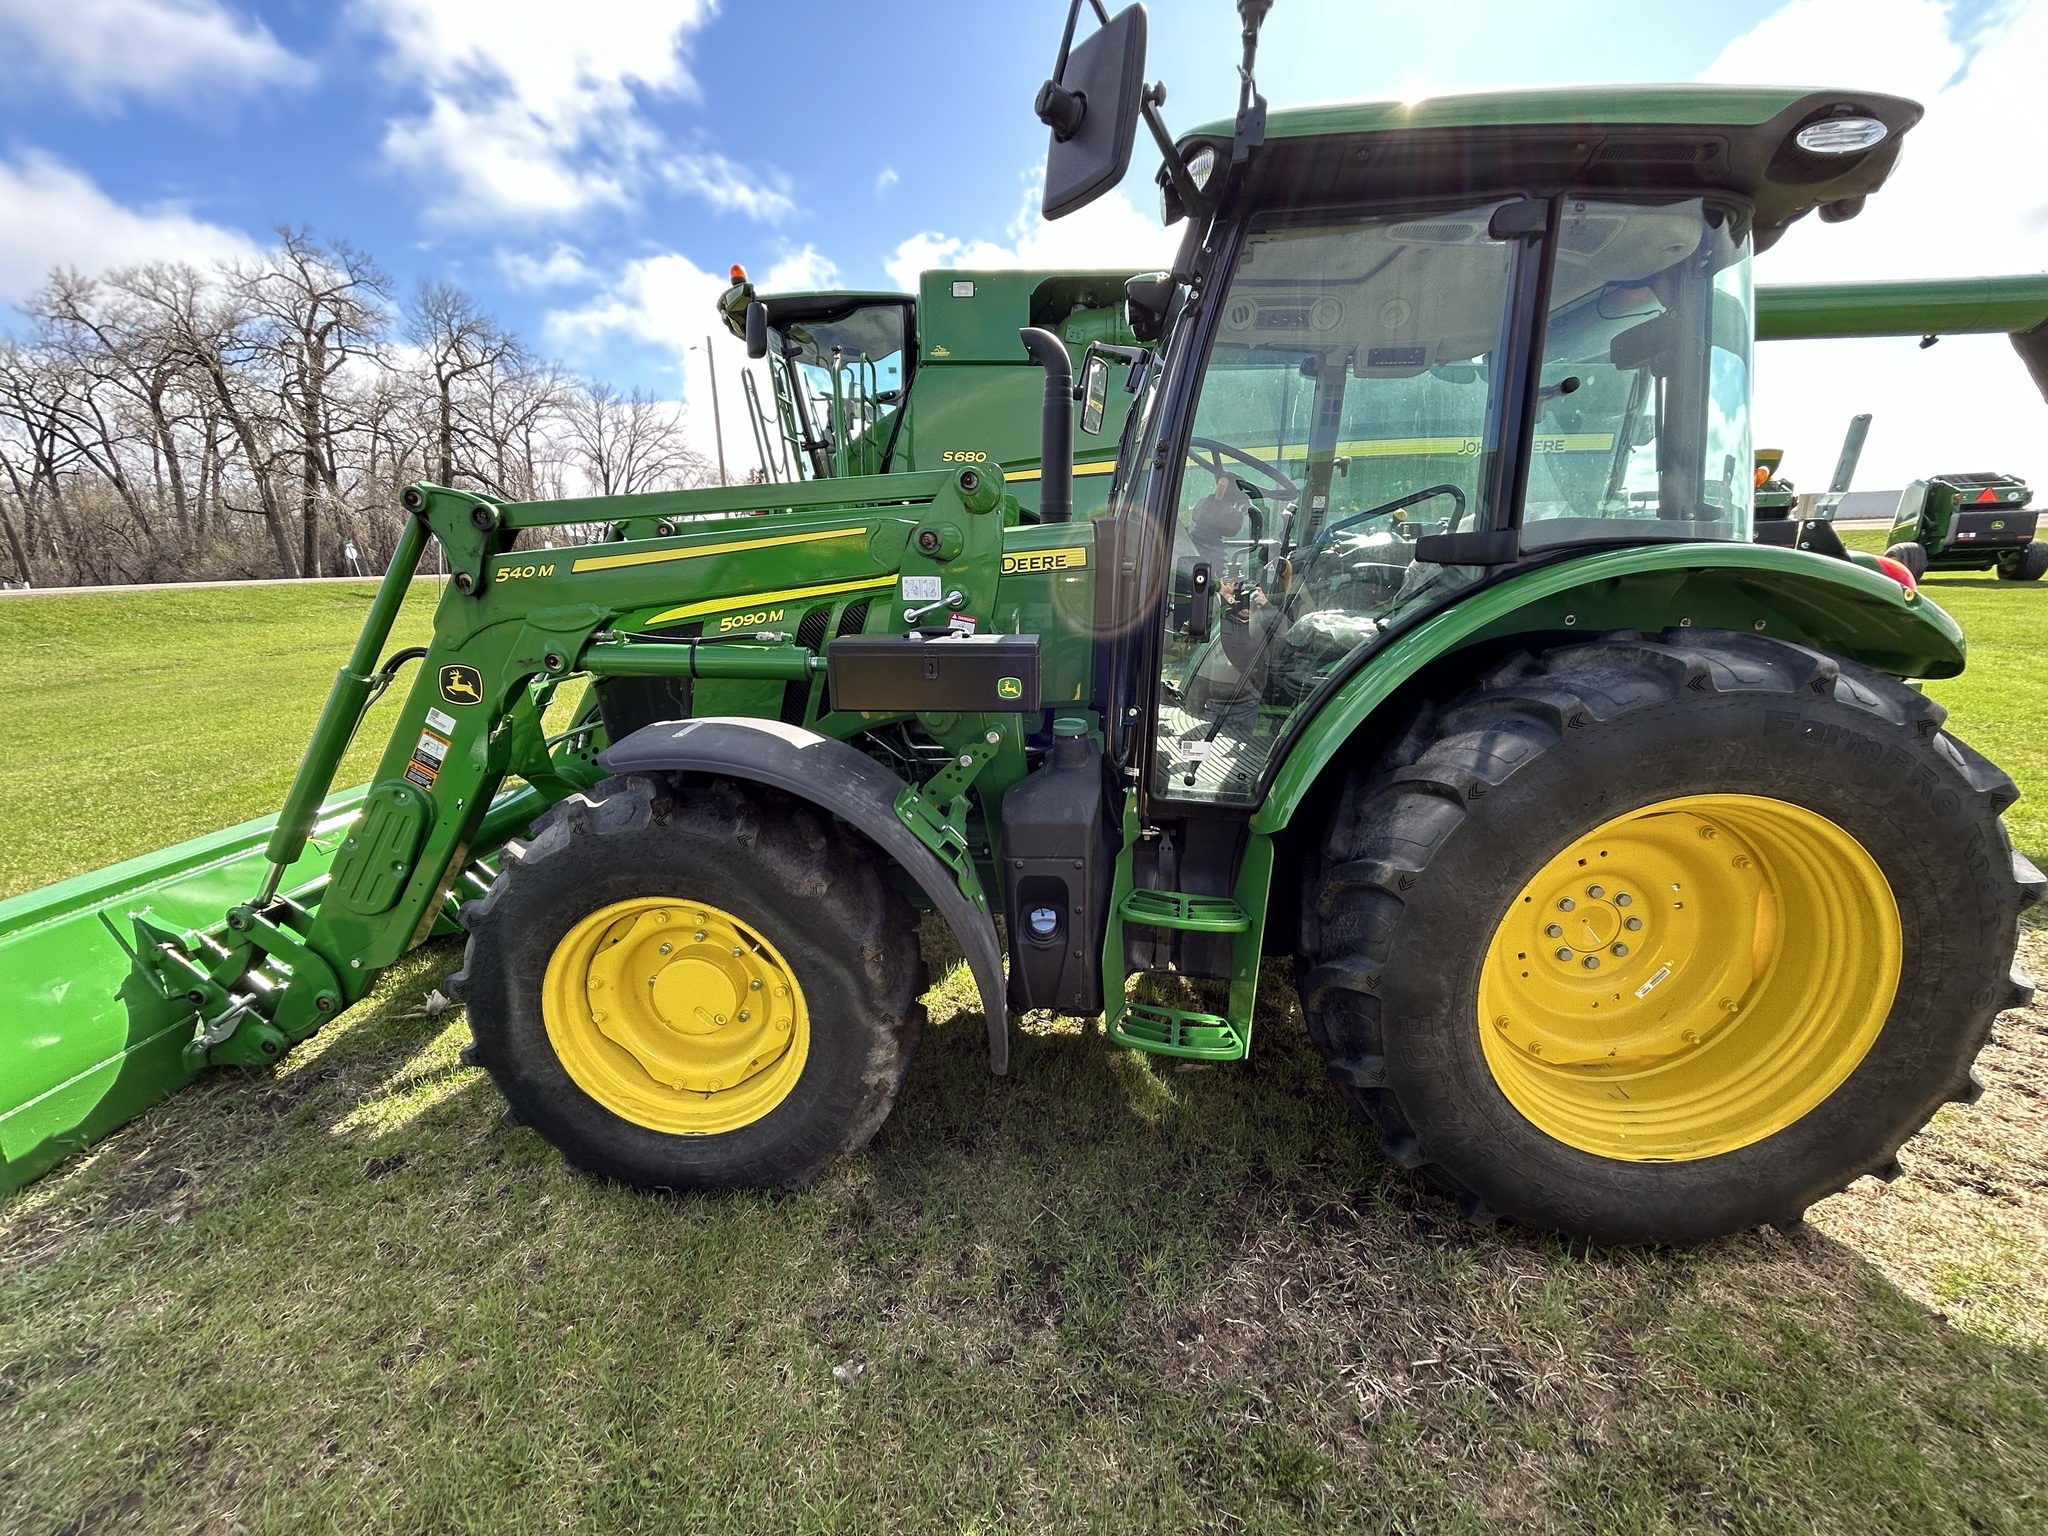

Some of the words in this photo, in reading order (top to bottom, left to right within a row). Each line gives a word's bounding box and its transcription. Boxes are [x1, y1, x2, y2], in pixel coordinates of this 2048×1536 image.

[1457, 440, 1483, 453] JOH
[1533, 440, 1565, 451] ERE
[942, 450, 987, 462] S680
[1002, 555, 1067, 572] DEERE
